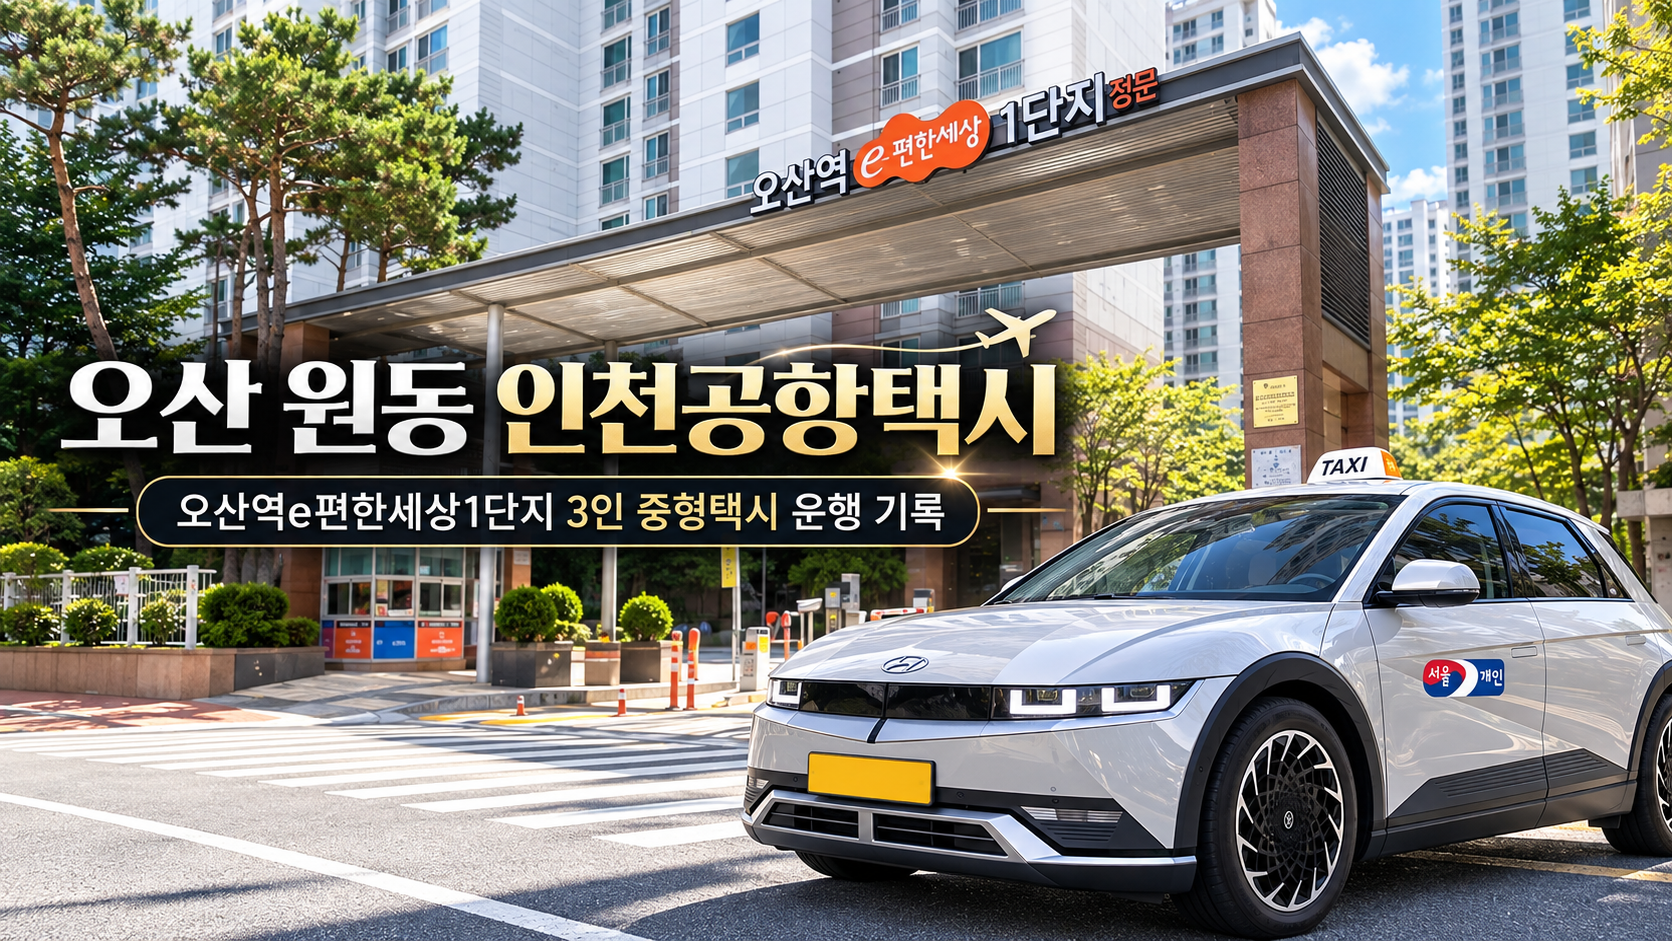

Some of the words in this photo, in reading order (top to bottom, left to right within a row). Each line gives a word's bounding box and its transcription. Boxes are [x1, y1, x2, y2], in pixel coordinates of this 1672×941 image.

[750, 149, 850, 215] 오산역
[999, 71, 1106, 146] 1단지
[1109, 66, 1159, 110] 정문
[1321, 456, 1369, 477] TAXI
[1479, 668, 1503, 687] 개인
